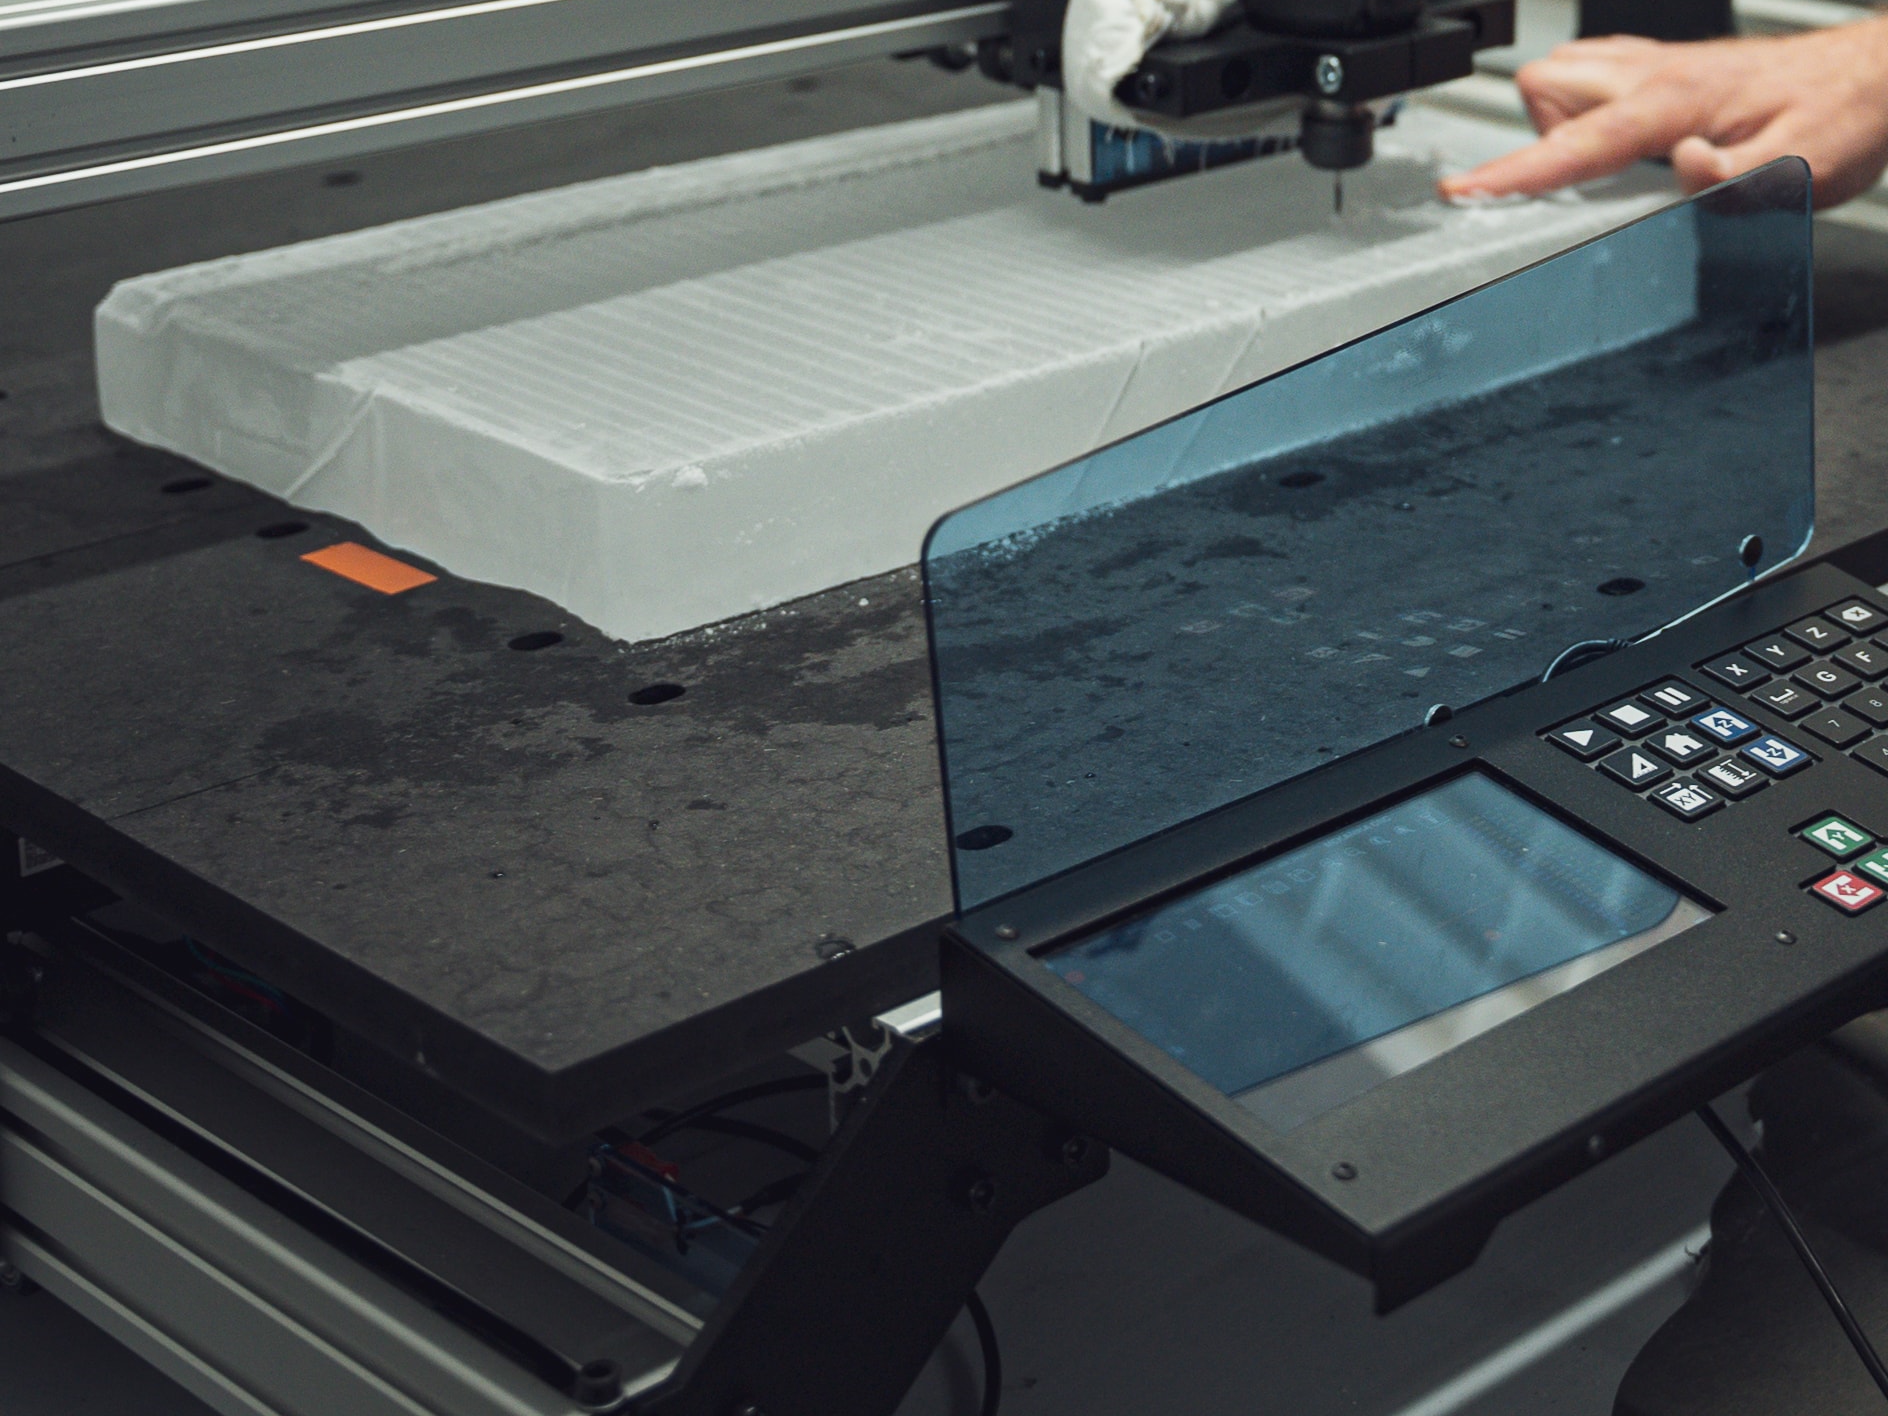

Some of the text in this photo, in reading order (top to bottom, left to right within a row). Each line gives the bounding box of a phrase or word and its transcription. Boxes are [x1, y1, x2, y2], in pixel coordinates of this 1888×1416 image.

[1805, 626, 1828, 639] Z
[1765, 644, 1785, 656] Y
[1855, 651, 1872, 664] F
[1725, 663, 1748, 676] X
[1816, 670, 1837, 682] G
[1869, 699, 1883, 708] 8
[1718, 718, 1733, 729] Z
[1827, 719, 1840, 728] 7
[1766, 747, 1781, 757] Z
[1674, 791, 1697, 806] XY
[1832, 831, 1845, 840] Y
[1841, 885, 1857, 894] X
